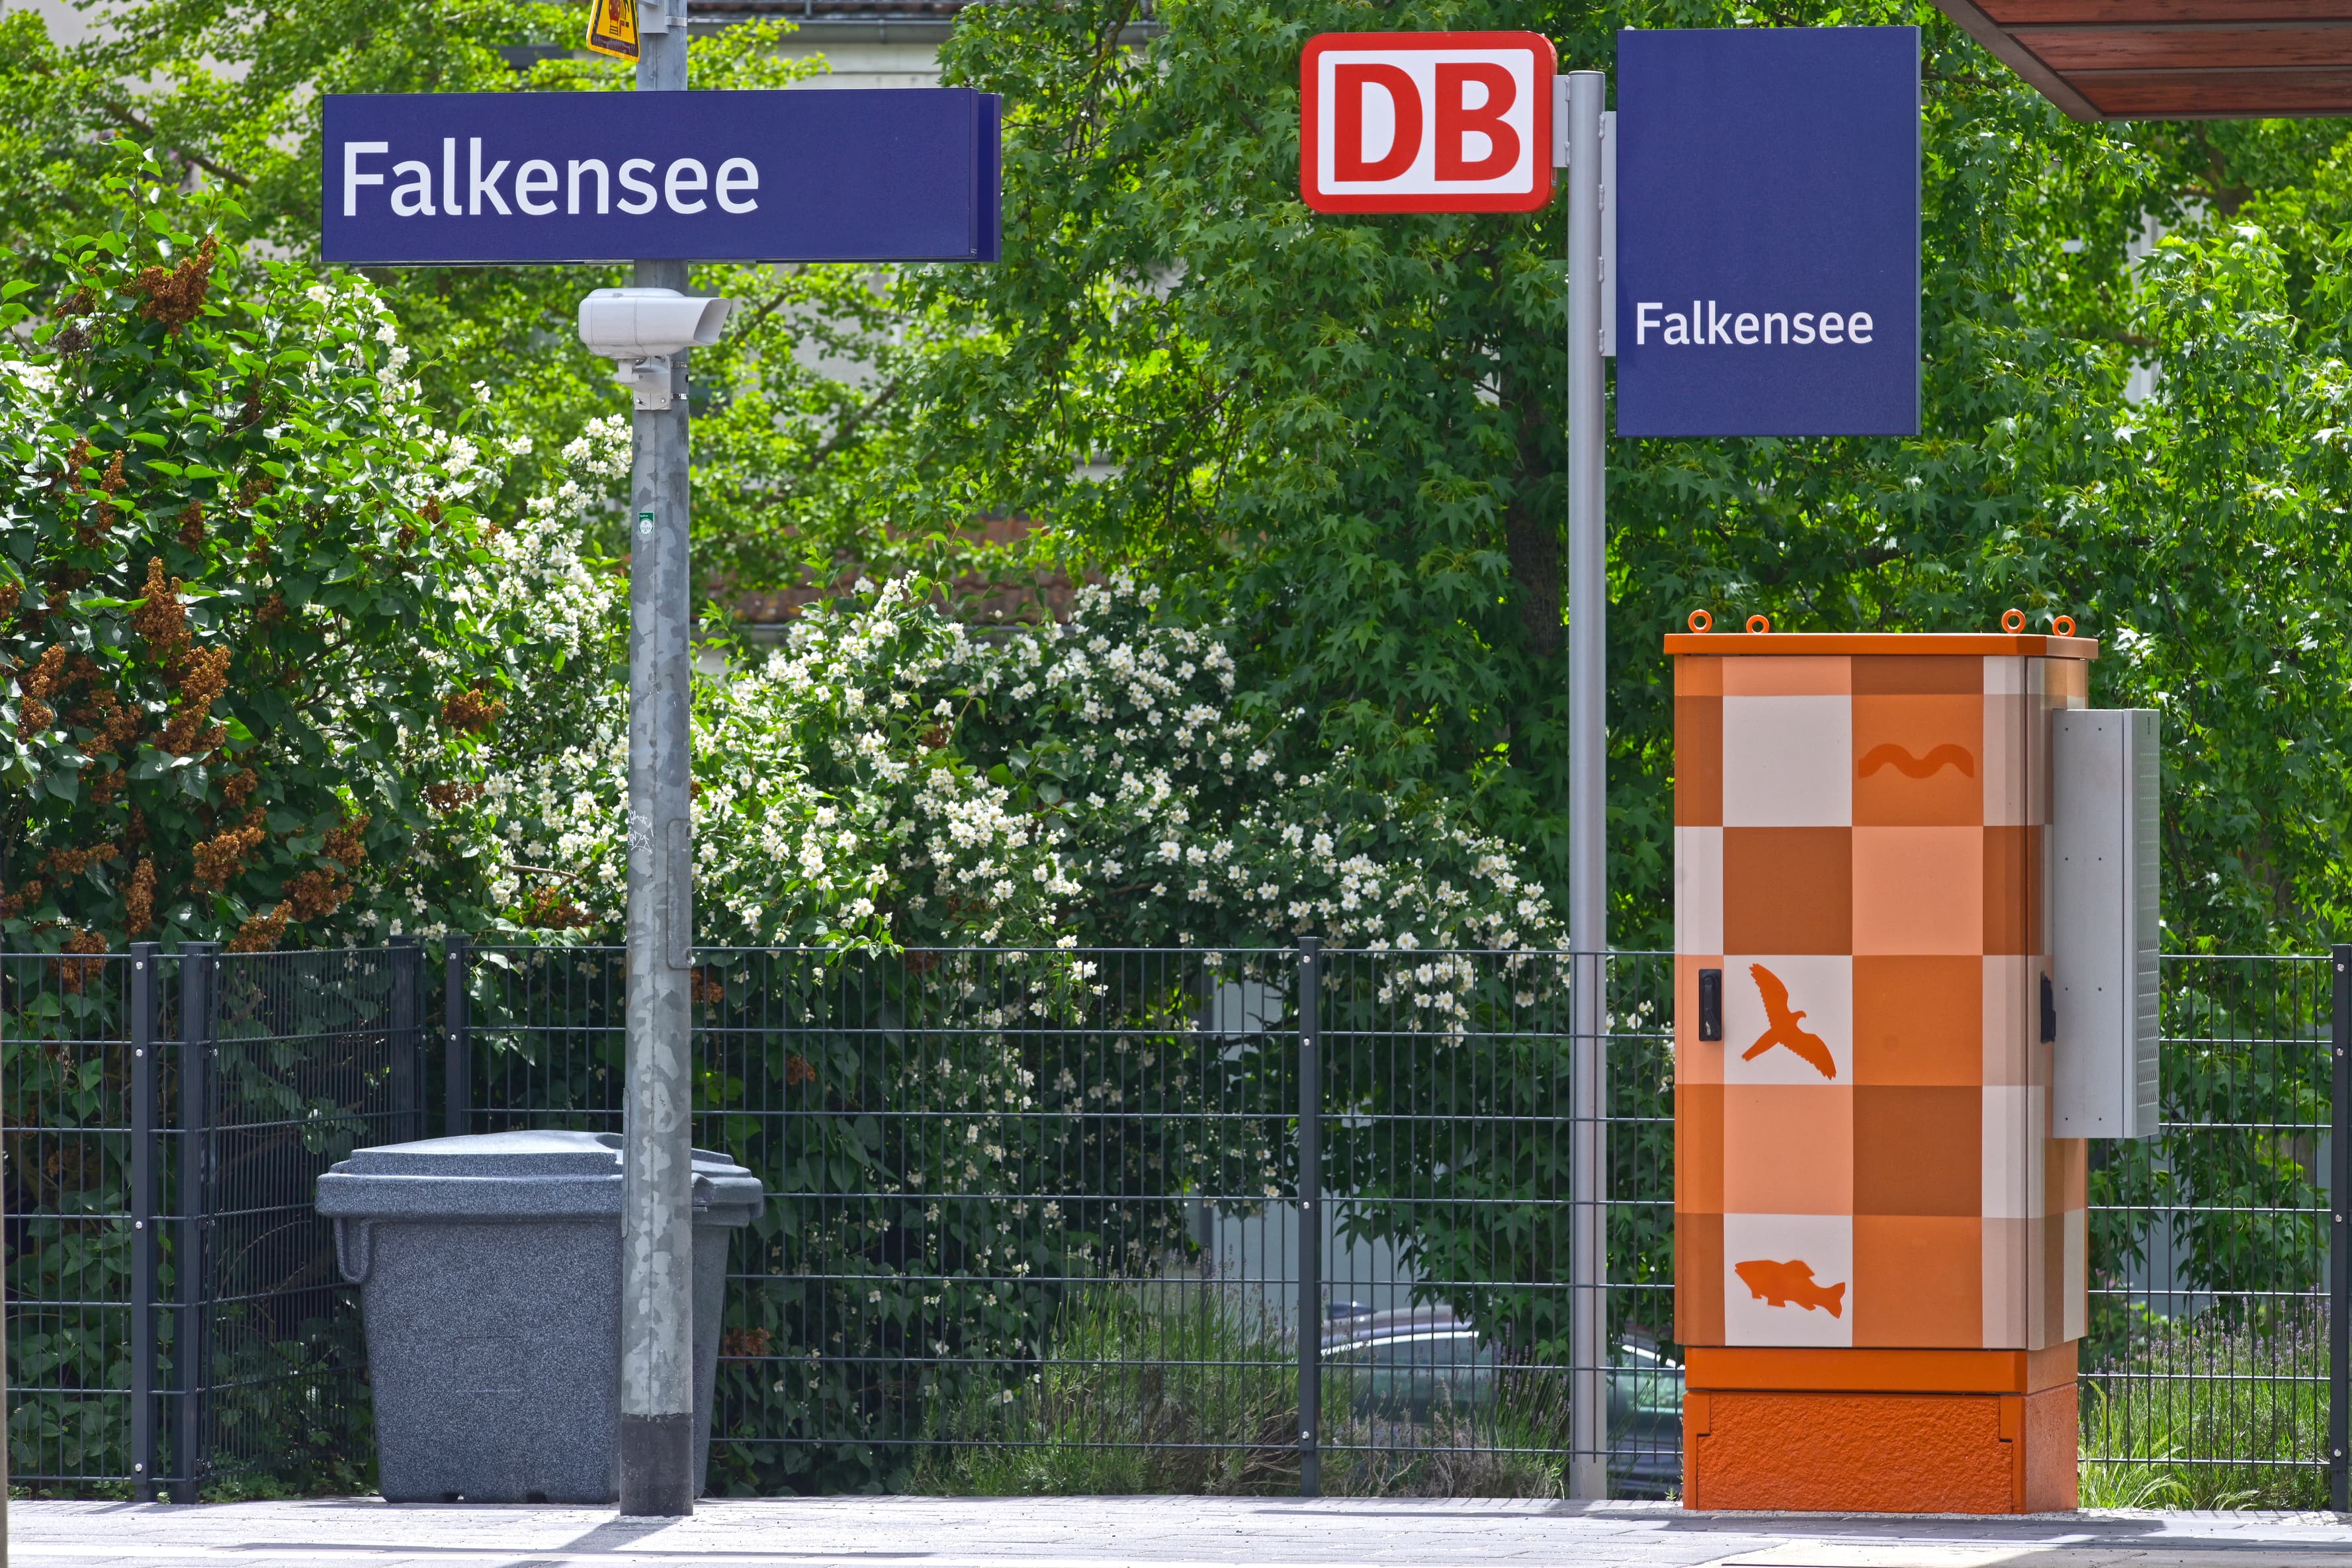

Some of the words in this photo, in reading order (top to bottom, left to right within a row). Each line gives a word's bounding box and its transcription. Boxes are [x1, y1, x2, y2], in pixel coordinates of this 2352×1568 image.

[1334, 62, 1520, 182] DB
[343, 137, 759, 217] Falkensee
[1637, 300, 1873, 345] Falkensee
